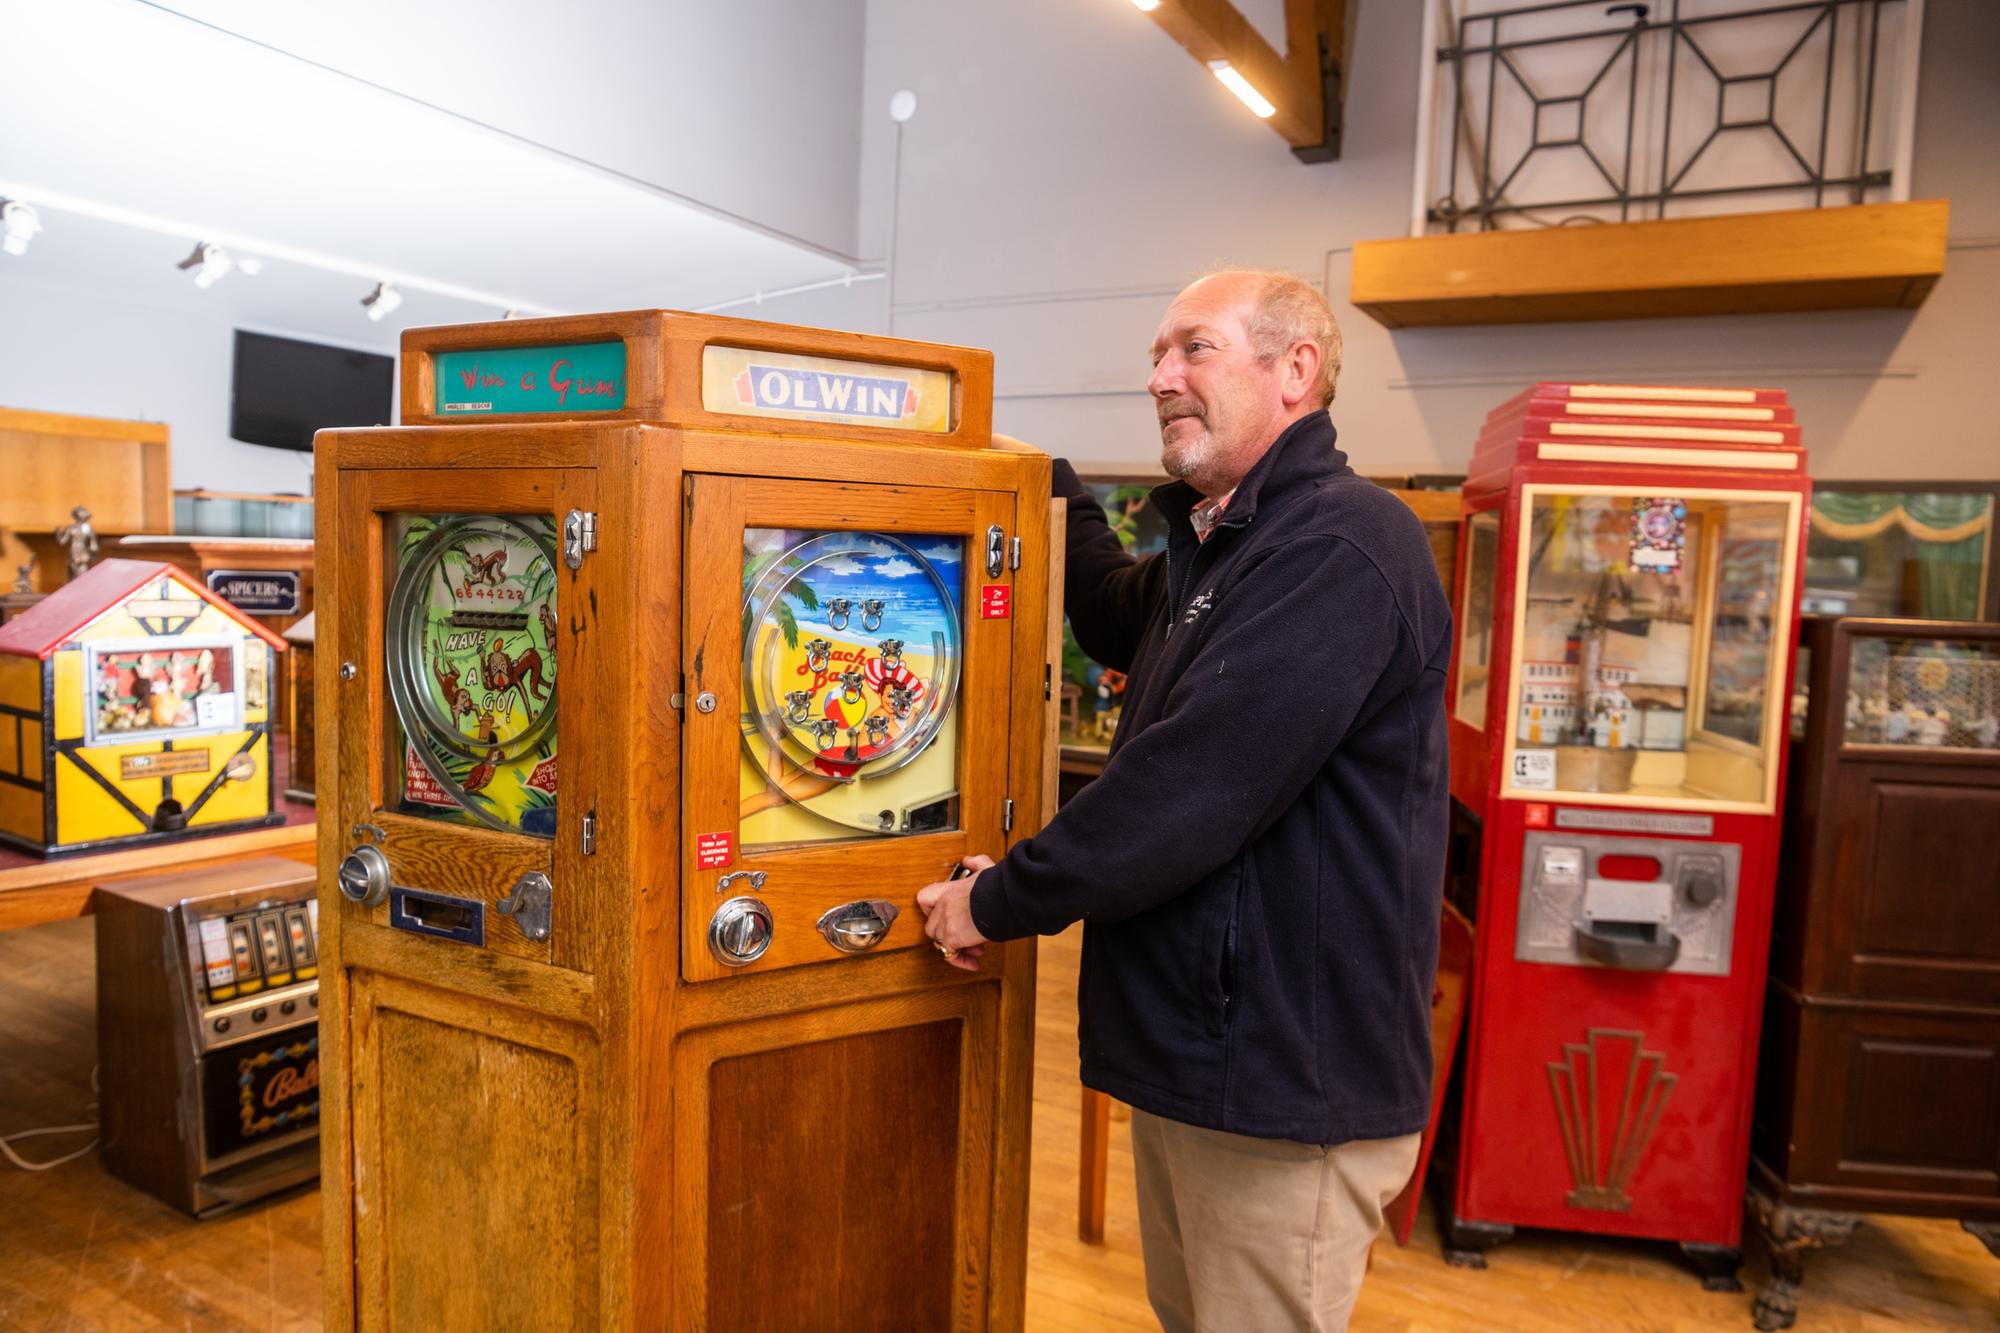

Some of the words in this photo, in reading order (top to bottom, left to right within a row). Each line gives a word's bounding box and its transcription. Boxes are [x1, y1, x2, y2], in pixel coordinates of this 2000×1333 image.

[460, 363, 508, 392] Win
[519, 371, 538, 392] a
[227, 580, 280, 597] SPICERS
[445, 630, 487, 651] HAVE
[465, 667, 478, 687] A
[482, 689, 516, 723] GO!
[413, 780, 429, 790] WIN
[532, 774, 548, 785] INTO
